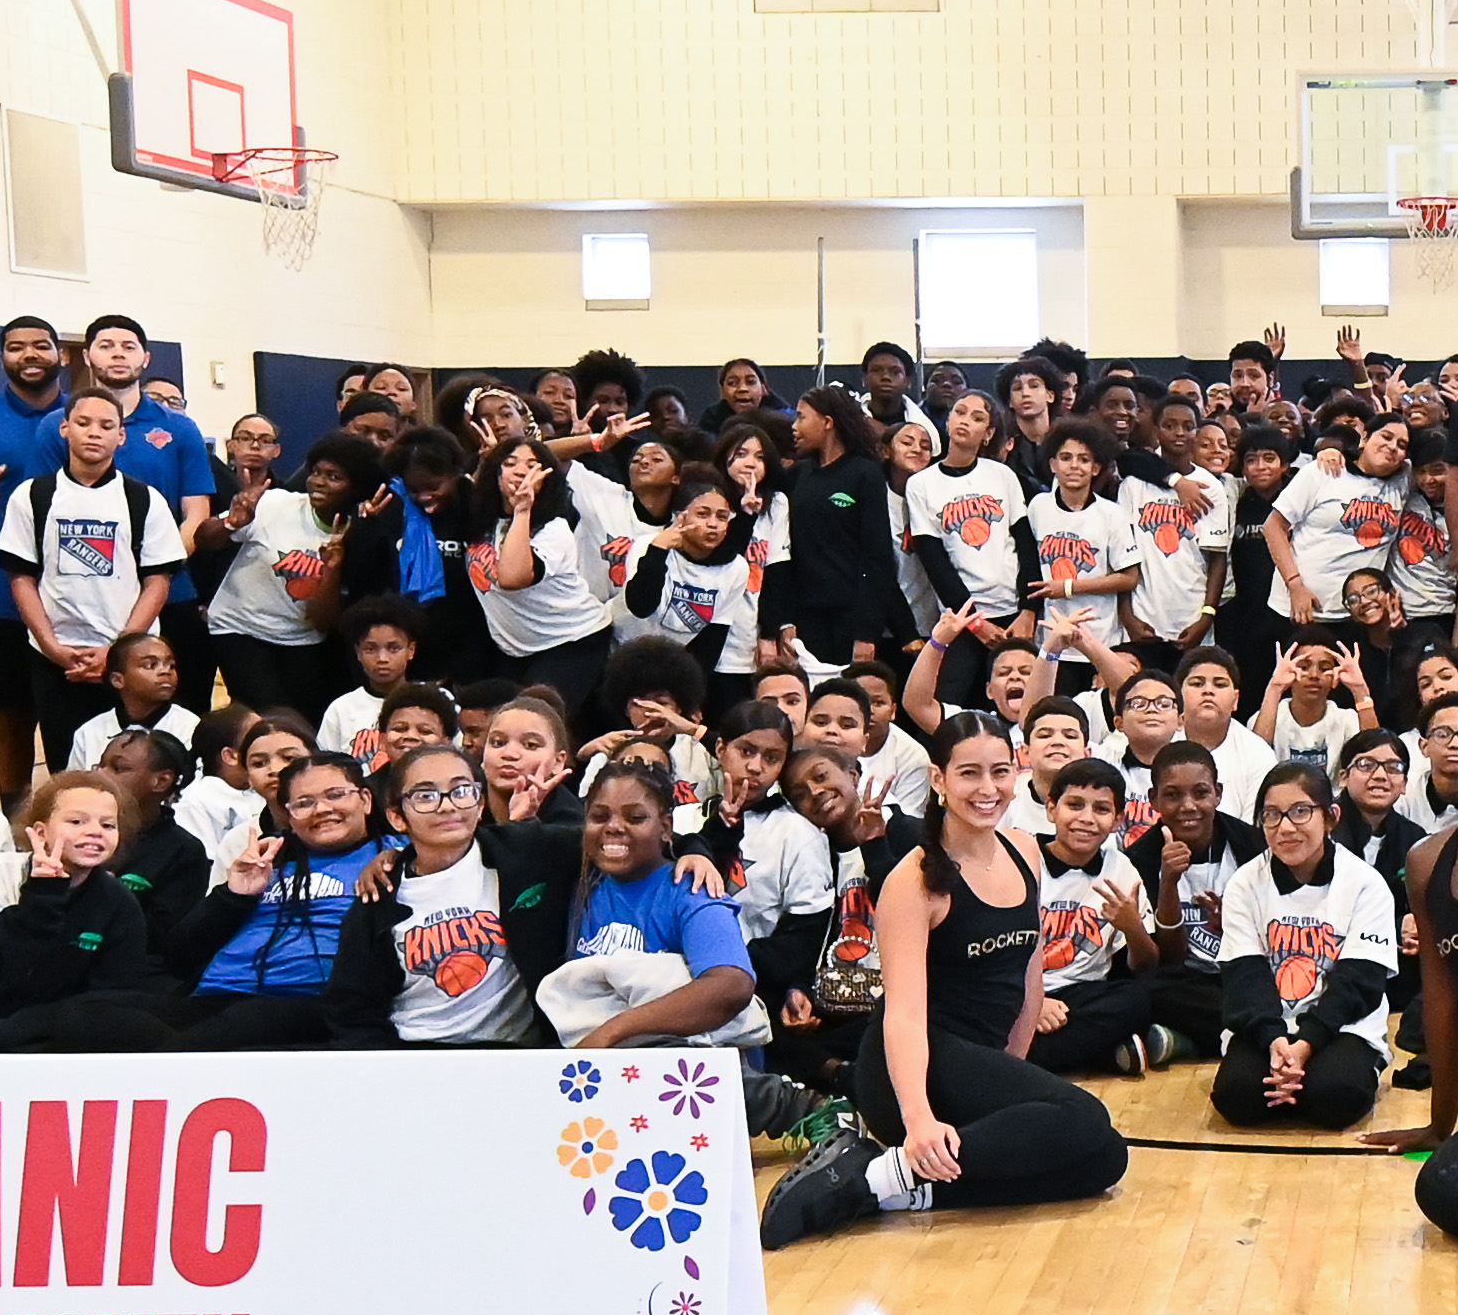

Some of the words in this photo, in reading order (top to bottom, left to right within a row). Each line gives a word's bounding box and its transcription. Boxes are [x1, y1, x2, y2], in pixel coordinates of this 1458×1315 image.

[59, 523, 84, 536] NEW
[87, 524, 115, 536] YORK
[942, 495, 1004, 532] KNICKS
[65, 539, 112, 577] RANGERS
[1040, 535, 1097, 567] KNICKS
[404, 910, 507, 970] KNICKS
[967, 930, 1041, 958] ROCKETT
[1189, 927, 1220, 953] RANG
